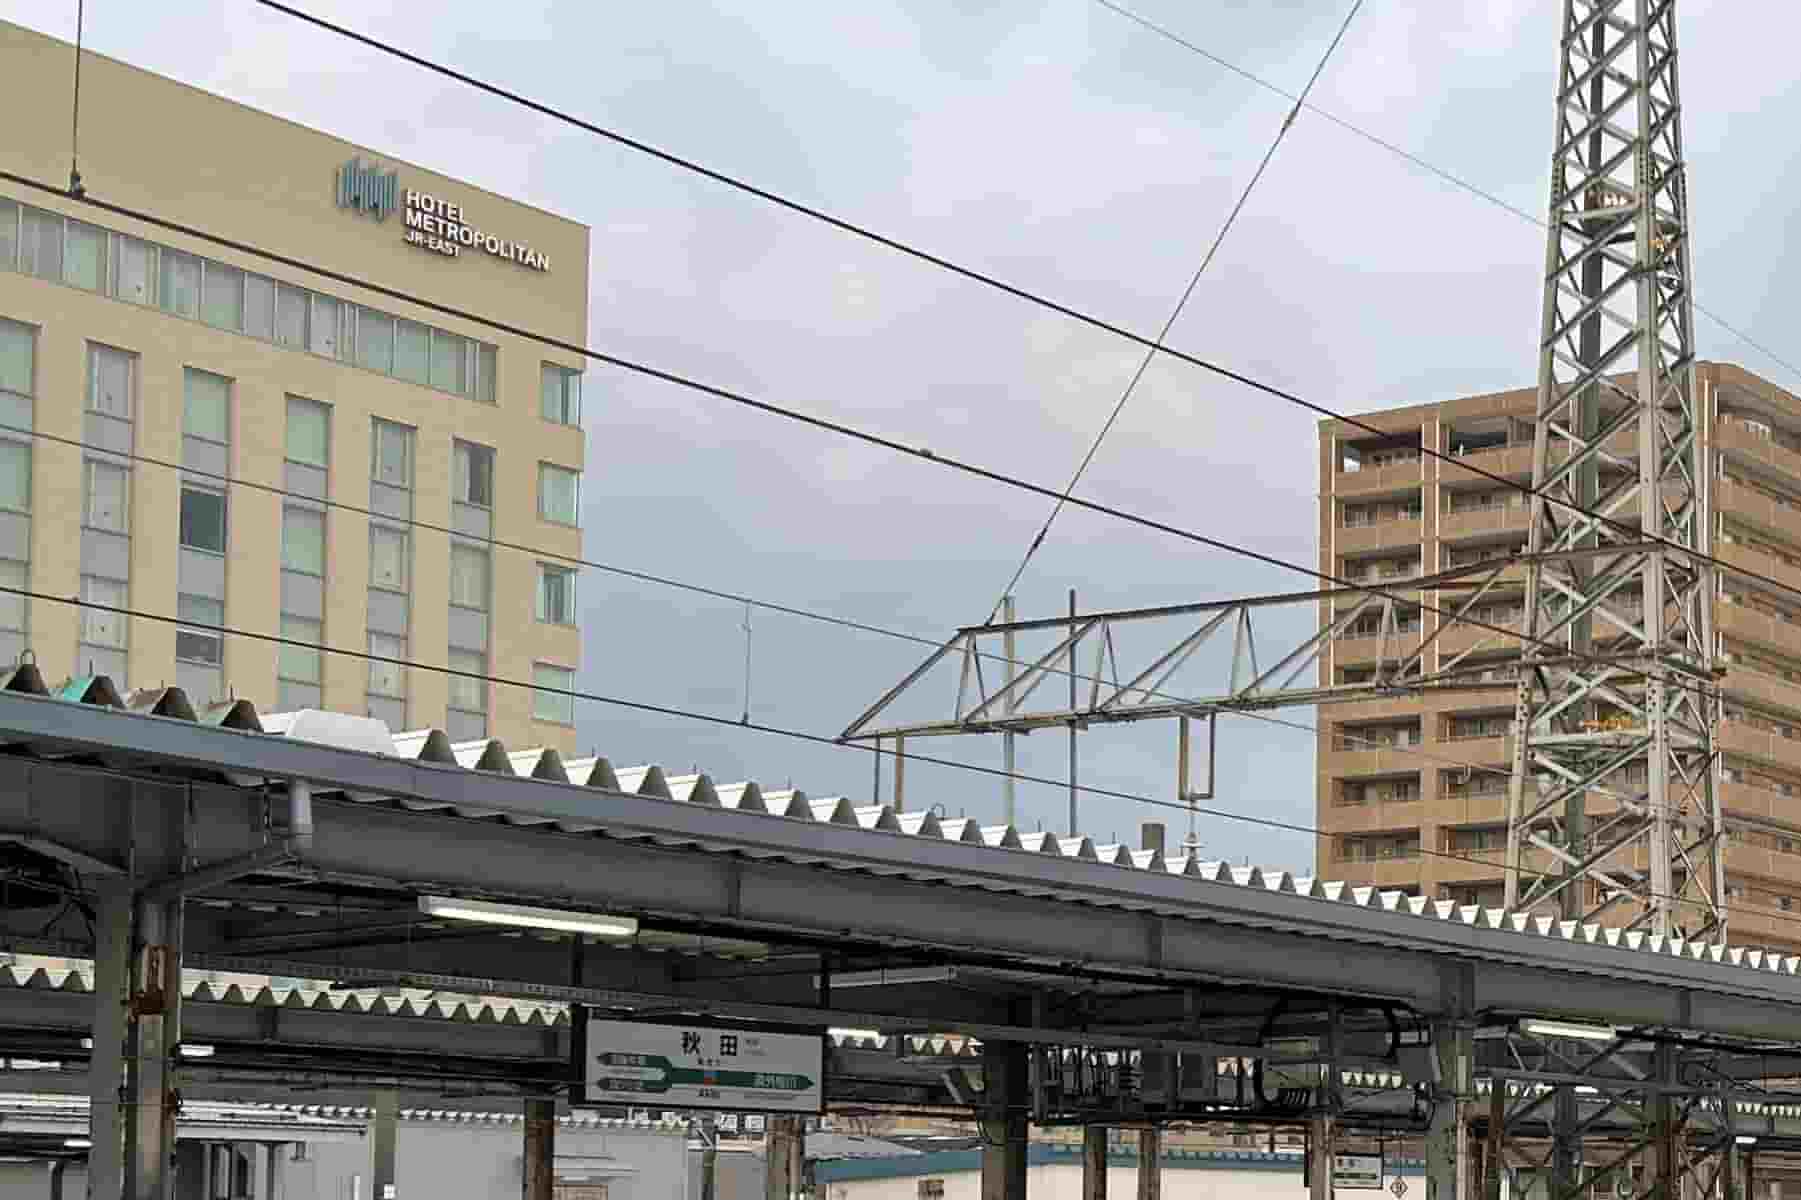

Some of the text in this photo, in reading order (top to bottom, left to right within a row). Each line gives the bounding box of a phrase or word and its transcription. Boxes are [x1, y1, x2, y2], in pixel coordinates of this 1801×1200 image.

[406, 187, 465, 224] HOTEL
[405, 207, 550, 272] METROPOLITAN
[405, 231, 461, 257] JR-EAST
